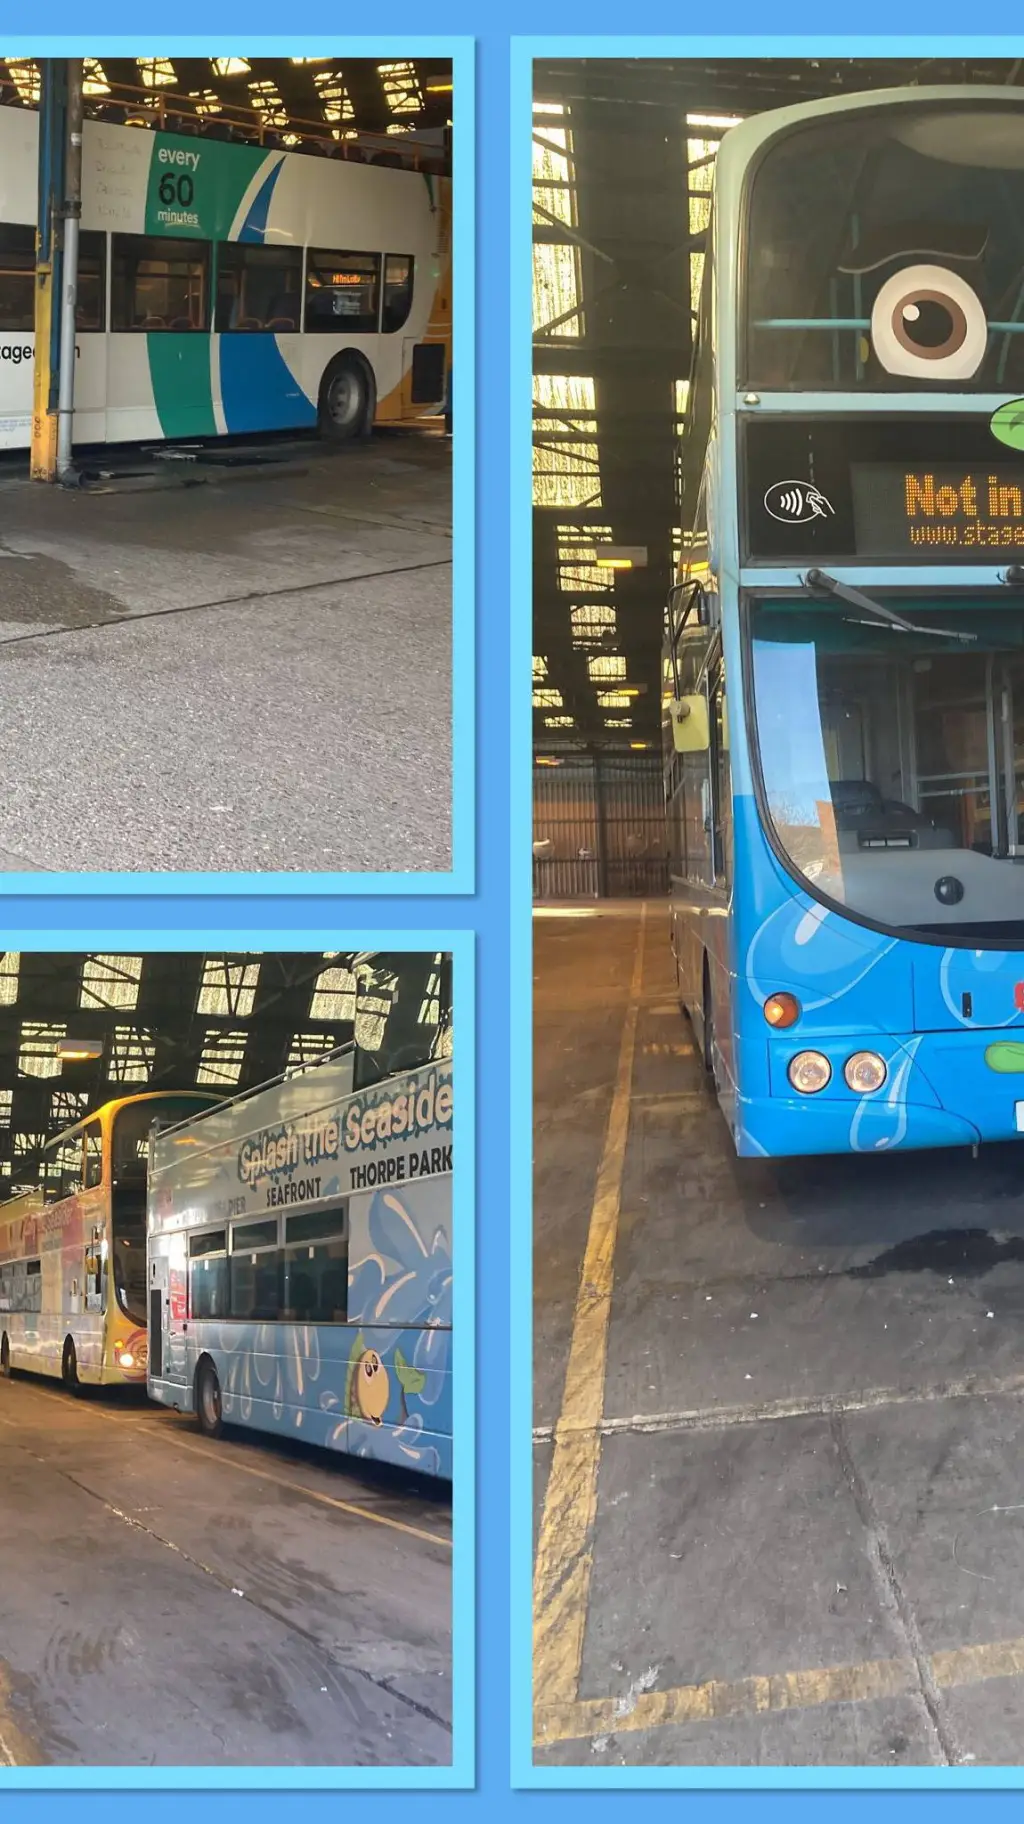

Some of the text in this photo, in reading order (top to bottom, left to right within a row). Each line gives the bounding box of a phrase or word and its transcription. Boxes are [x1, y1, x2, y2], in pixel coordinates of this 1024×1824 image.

[158, 147, 201, 172] every
[159, 172, 194, 207] 60
[157, 208, 199, 224] minutes
[905, 474, 1022, 516] Not in
[239, 1073, 453, 1187] Splash the Seaside
[266, 1177, 322, 1207] SEAFRONT
[350, 1155, 406, 1189] THORPE
[409, 1145, 453, 1177] PARK
